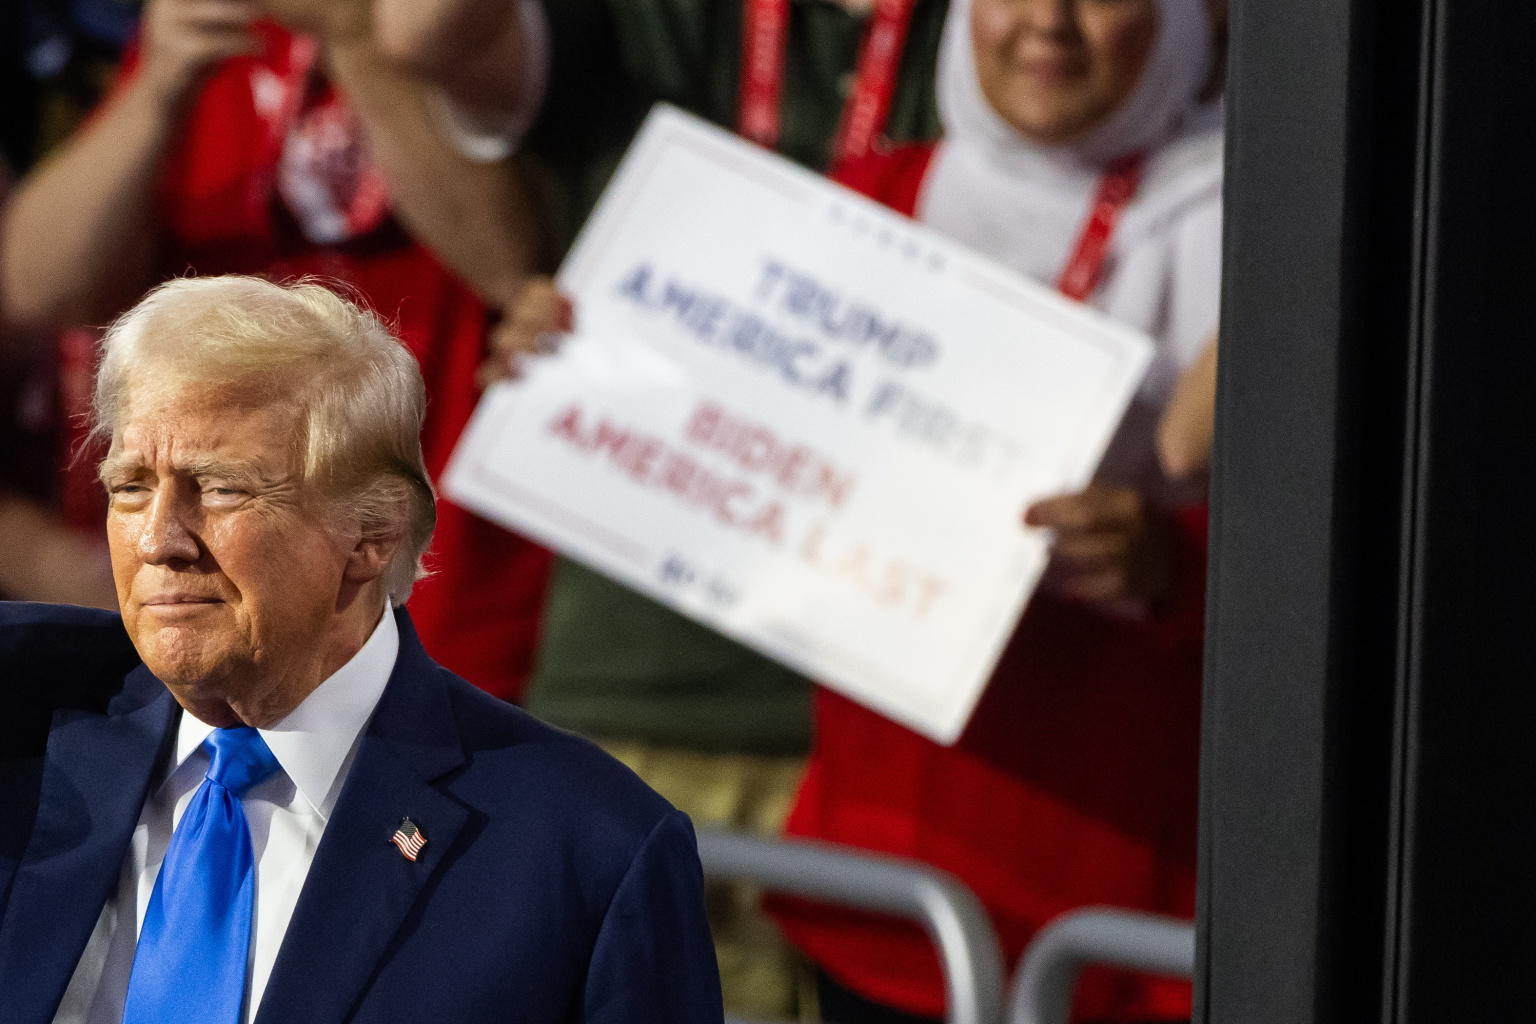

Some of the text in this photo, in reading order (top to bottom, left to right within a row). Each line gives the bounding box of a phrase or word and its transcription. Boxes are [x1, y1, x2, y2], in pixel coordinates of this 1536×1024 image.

[616, 262, 1026, 482] AMERICA FIRST
[754, 255, 942, 370] TRUMP
[544, 402, 788, 550] AMERICA
[797, 517, 953, 620] LAST
[683, 399, 858, 509] BIDEN
